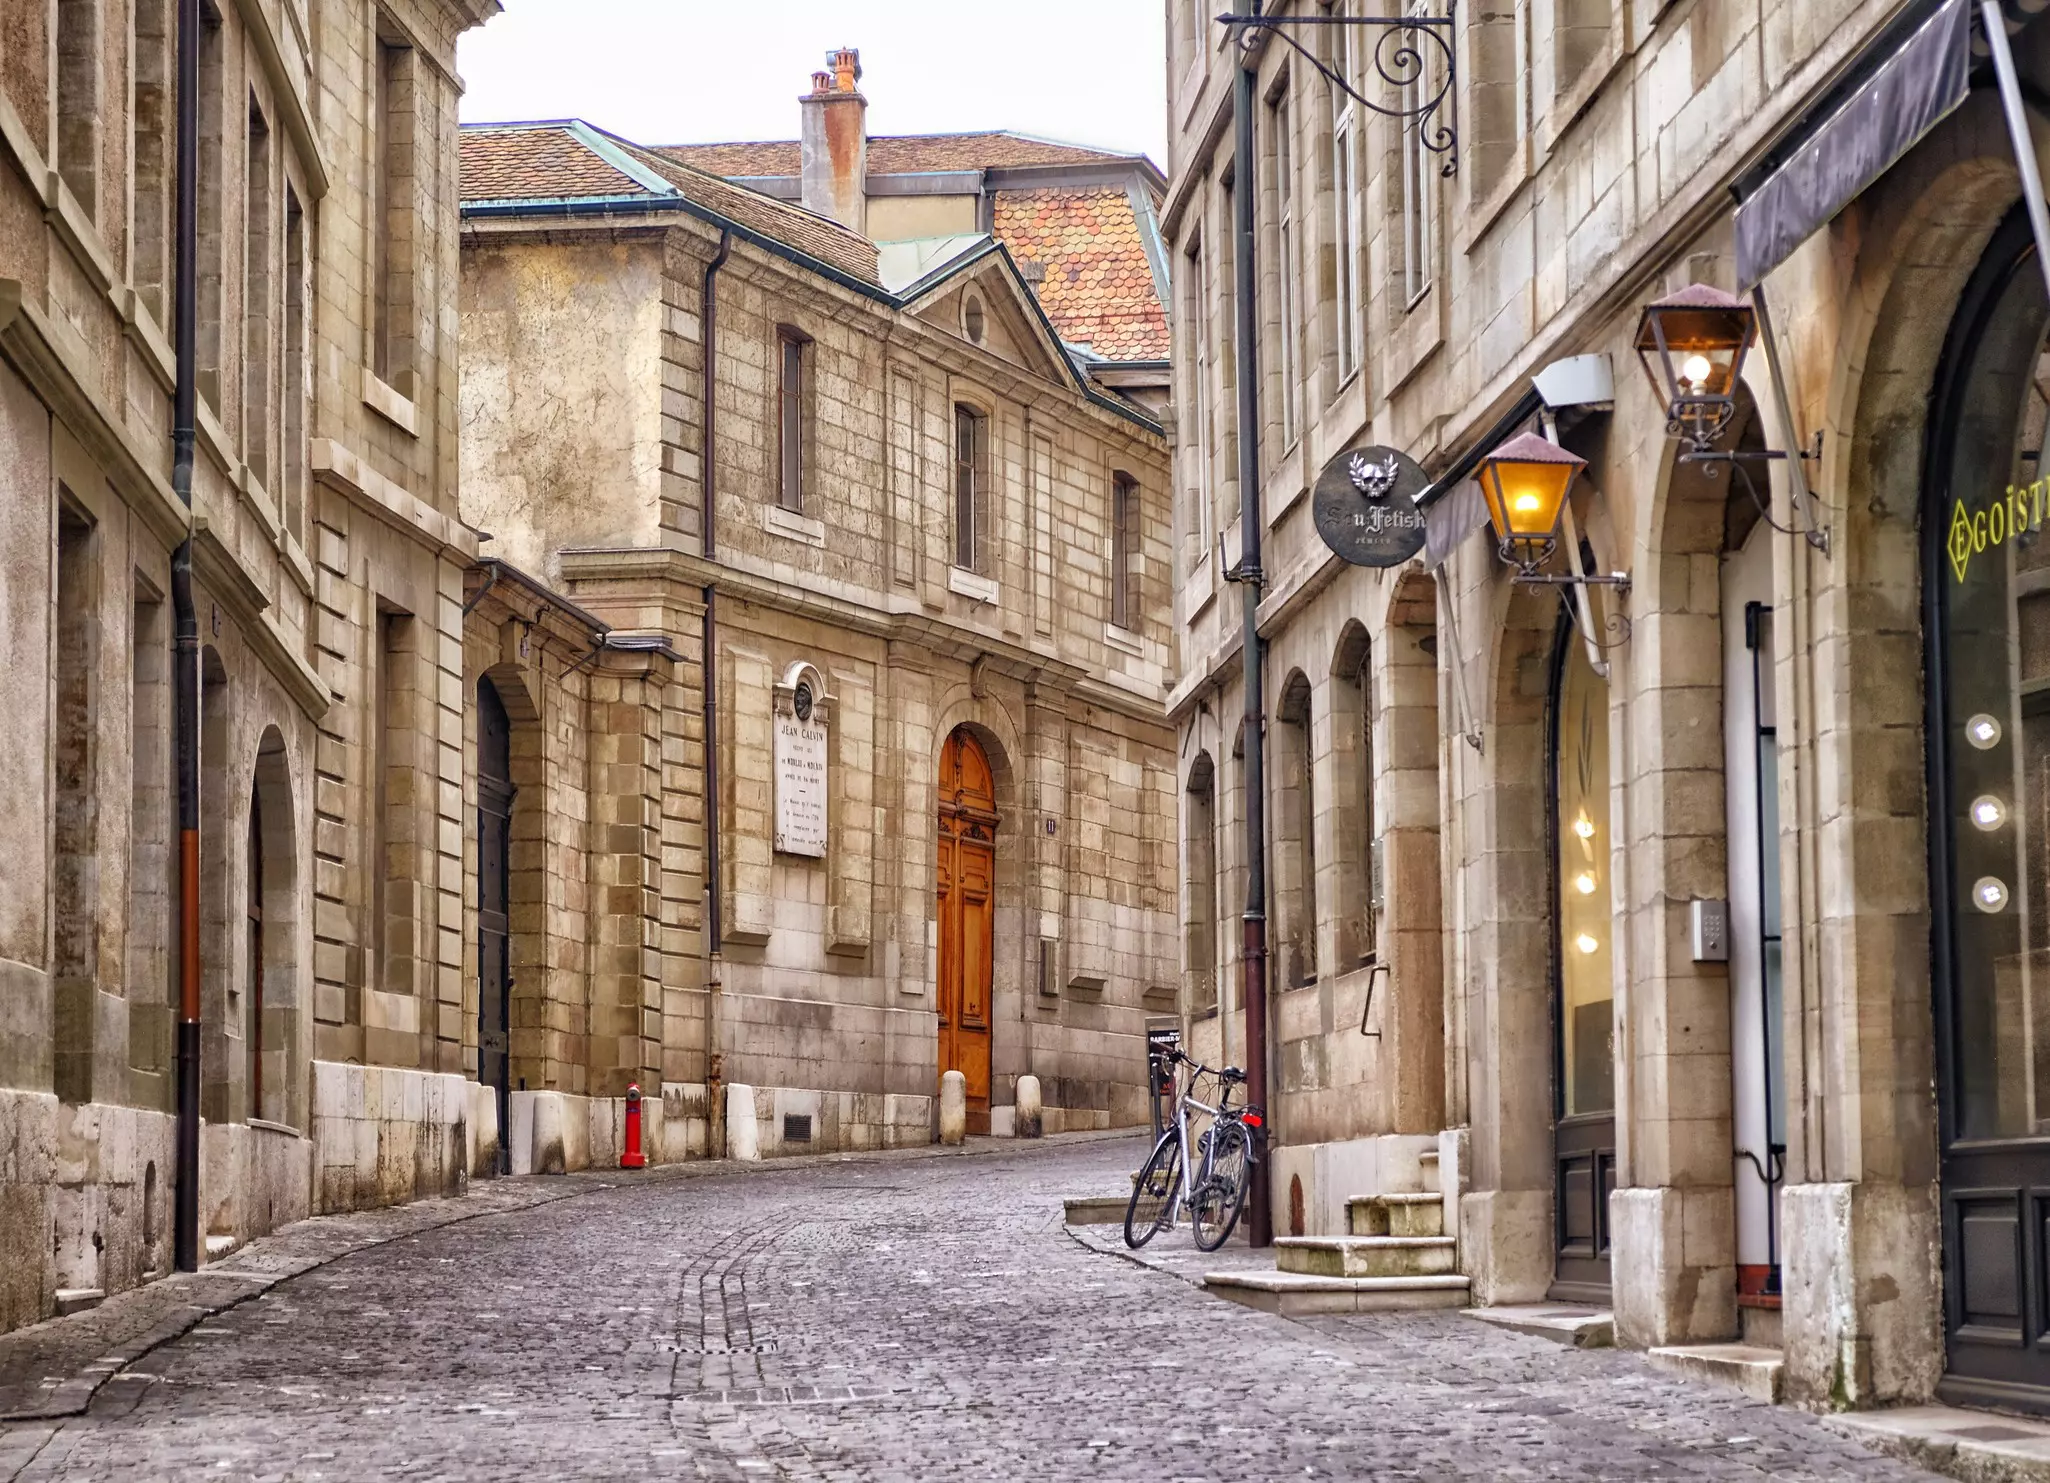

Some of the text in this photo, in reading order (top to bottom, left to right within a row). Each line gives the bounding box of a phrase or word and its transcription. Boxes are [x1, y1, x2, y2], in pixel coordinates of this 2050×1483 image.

[1365, 505, 1427, 534] Fetish
[781, 724, 823, 742] JEAN CALVIN
[1048, 820, 1054, 832] 11
